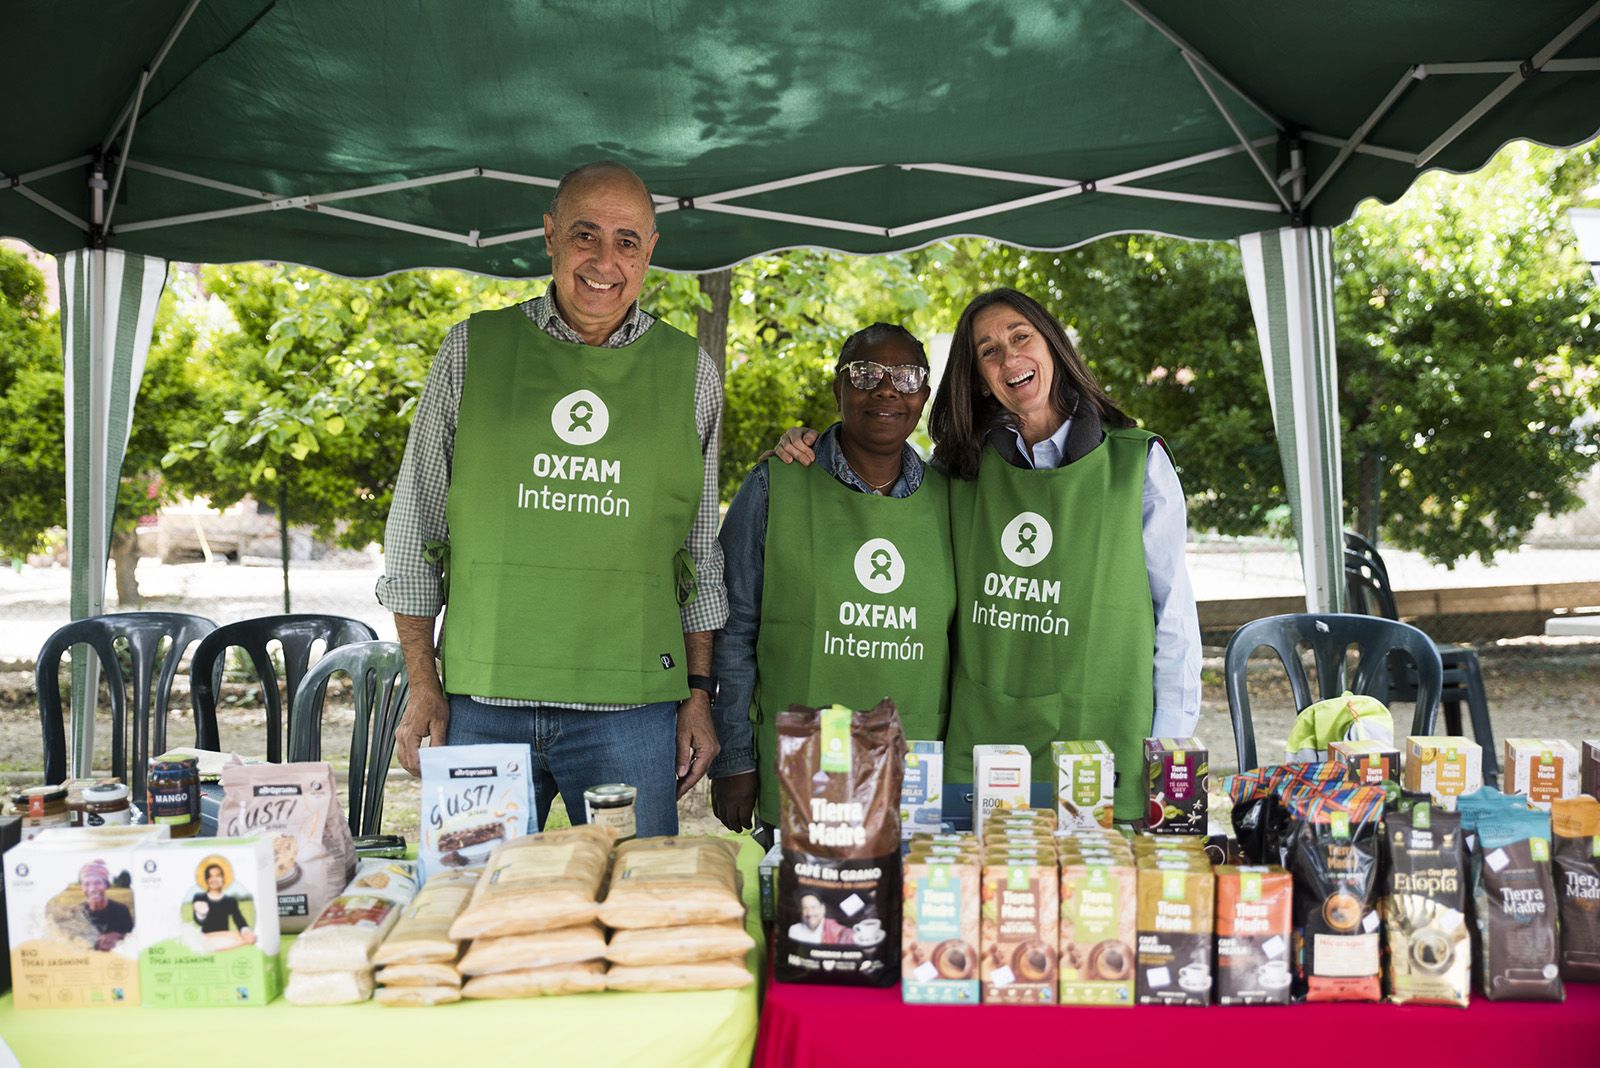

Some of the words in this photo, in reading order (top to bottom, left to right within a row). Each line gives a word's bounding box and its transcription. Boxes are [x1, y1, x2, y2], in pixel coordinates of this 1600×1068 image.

[533, 453, 621, 484] OXFAM
[518, 483, 630, 517] Intermón
[983, 572, 1061, 604] OXFAM
[839, 601, 917, 629] OXFAM
[972, 600, 1069, 636] Intermón
[824, 631, 924, 660] Intermón
[155, 793, 188, 804] MANGO
[809, 798, 863, 822] Tierra
[808, 822, 866, 846] Madre
[1565, 871, 1600, 886] Tierr
[1500, 887, 1544, 901] Tierra
[1566, 884, 1600, 899] Madr
[1157, 901, 1192, 916] Tierra
[1503, 900, 1546, 914] Madre
[1155, 914, 1192, 930] Madre
